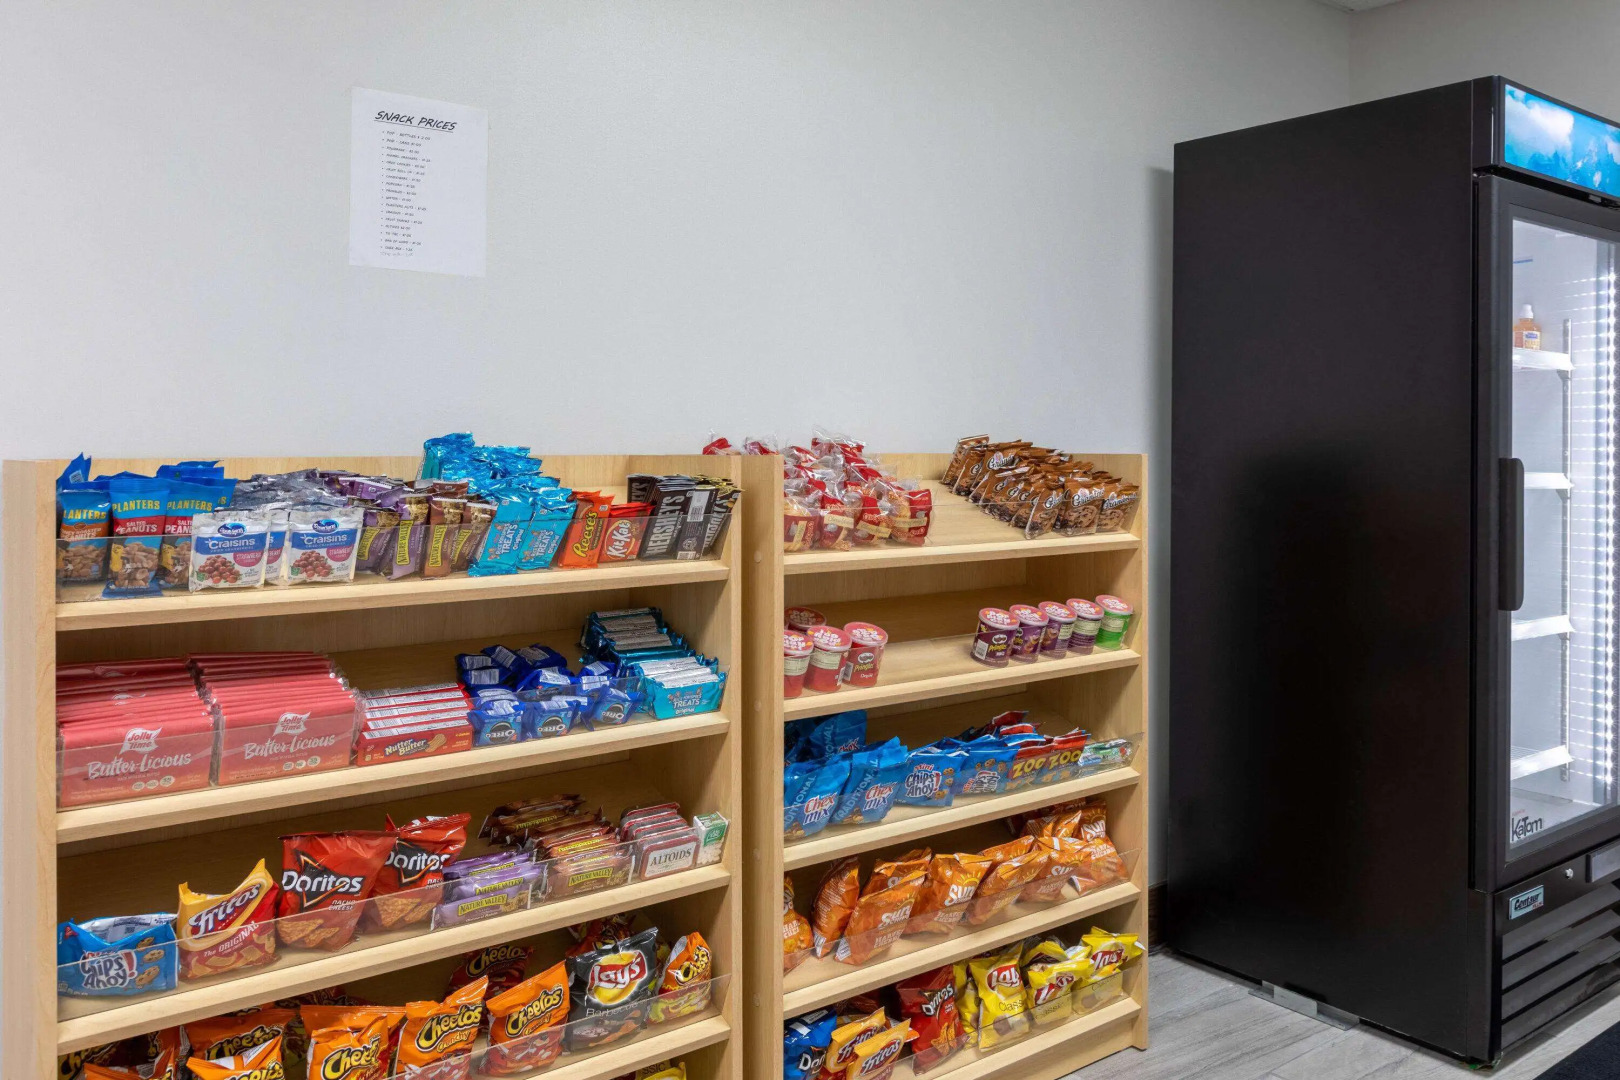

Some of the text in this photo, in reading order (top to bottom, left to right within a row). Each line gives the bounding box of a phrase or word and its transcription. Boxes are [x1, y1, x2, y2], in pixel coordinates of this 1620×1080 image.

[375, 110, 458, 131] SNACK PRICES
[112, 500, 160, 514] PLANTERS
[166, 500, 213, 512] PLANTERS
[572, 511, 598, 558] Reese's
[646, 494, 685, 556] HERSHEY'S
[208, 538, 256, 550] Craisins
[304, 534, 348, 545] Craisins
[398, 522, 412, 564] NATURE VALLEY
[430, 526, 447, 565] NATURE VALLEY
[502, 524, 518, 554] TREATS
[536, 531, 554, 556] TREATS
[854, 664, 874, 672] Pringles
[674, 699, 700, 709] TREATS
[281, 716, 303, 726] Jolly
[602, 711, 625, 720] OREO
[128, 731, 152, 742] Jolly
[486, 729, 516, 738] OREO
[538, 724, 566, 732] OREO
[244, 734, 336, 760] Butter-Licious
[385, 739, 413, 756] Nutter
[399, 740, 427, 756] Butter
[88, 753, 192, 780] Butter-Licious
[914, 764, 934, 772] Mini
[1049, 750, 1082, 770] ZOO
[905, 772, 935, 789] Chips
[865, 784, 894, 800] Chex
[805, 794, 835, 814] Chex
[1511, 816, 1543, 842] KaTom
[650, 848, 692, 866] ALTOIDS
[282, 871, 364, 892] Doritos
[570, 868, 612, 884] NATURE VALLEY
[189, 882, 262, 938] Fritos
[460, 895, 506, 914] NATURE VALLEY
[1514, 892, 1541, 911] Centaur
[219, 921, 260, 953] ORIGINAL
[467, 945, 526, 977] Cheeto
[595, 957, 641, 989] Lay's
[992, 966, 1022, 991] Lay
[586, 1003, 638, 1017] Barbecue
[922, 984, 954, 1016] Doritos
[998, 1001, 1025, 1012] Class
[506, 988, 563, 1037] Cheetos
[416, 1003, 482, 1052] Cheetos
[437, 1029, 470, 1053] Crunchy
[642, 1062, 666, 1074] SSIC
[800, 1051, 826, 1071] Dori
[861, 1040, 900, 1076] Fritos
